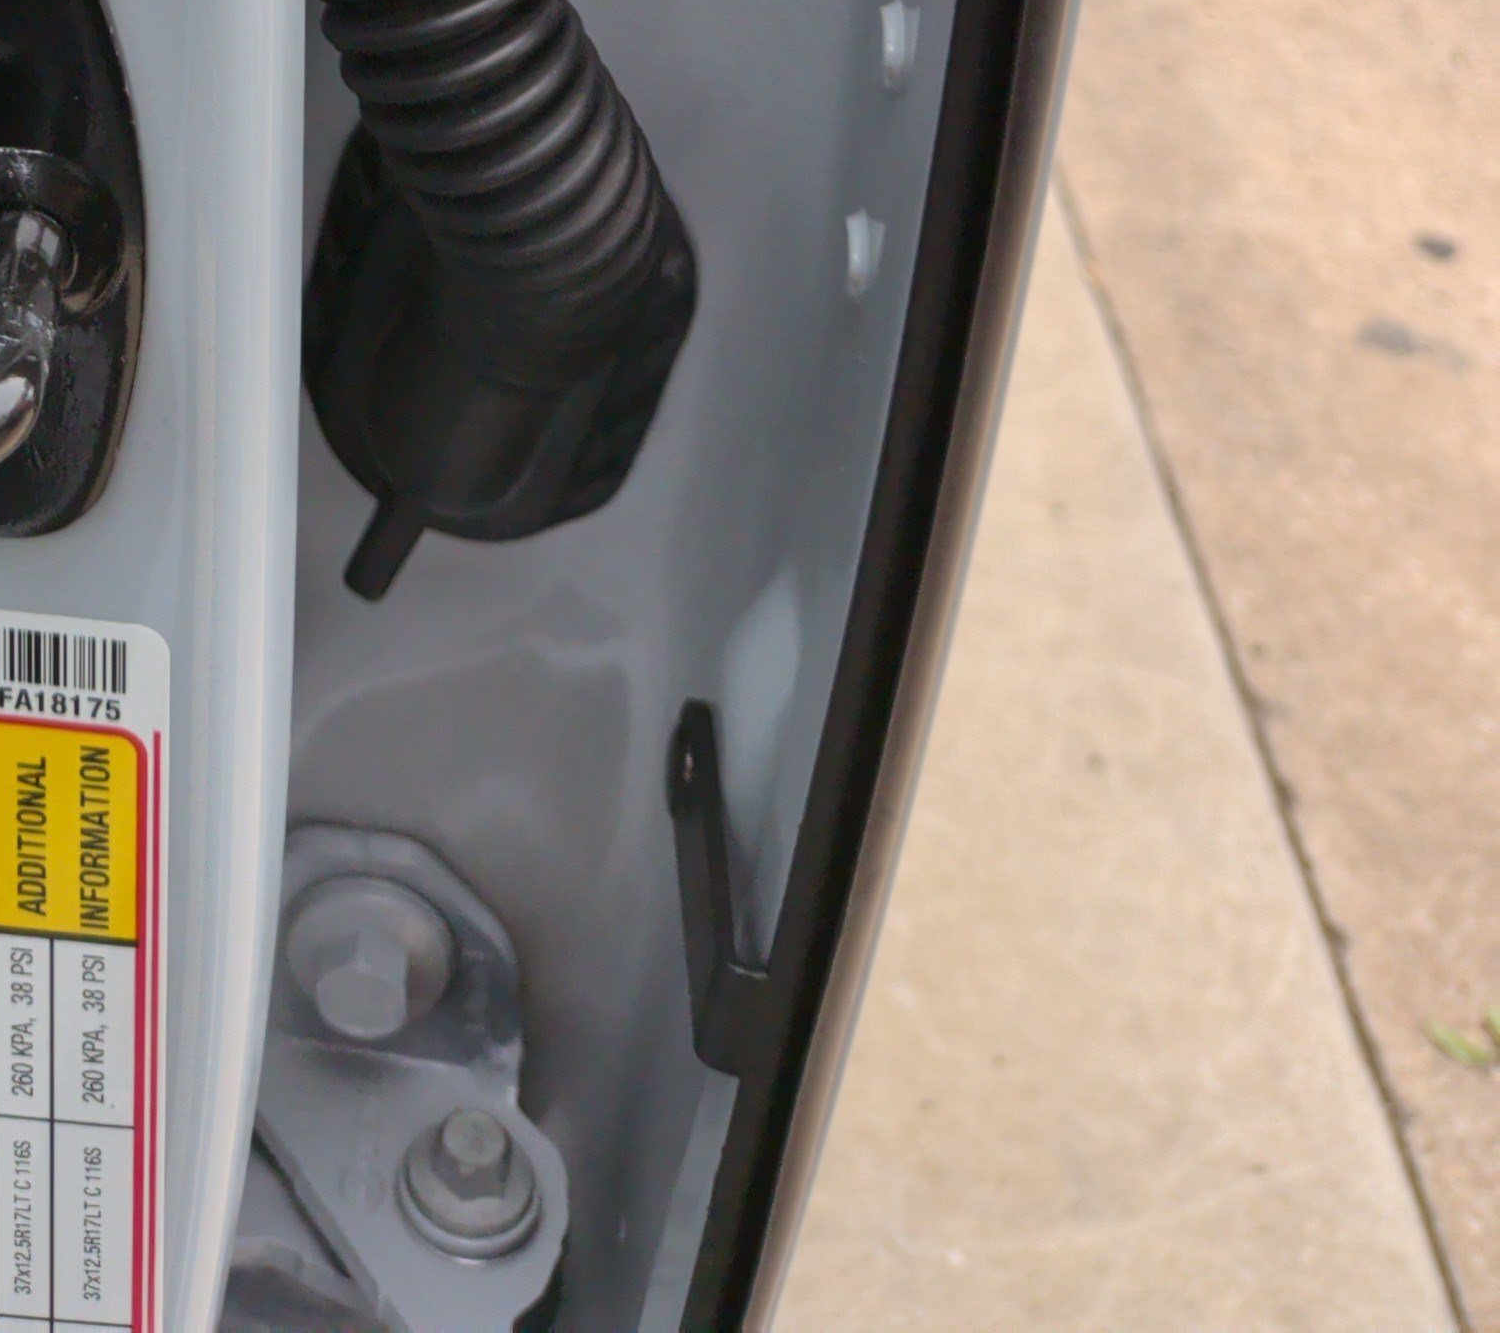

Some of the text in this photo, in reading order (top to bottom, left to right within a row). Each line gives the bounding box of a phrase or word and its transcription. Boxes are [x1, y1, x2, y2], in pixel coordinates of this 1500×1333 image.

[17, 757, 46, 916] ADDITIONAL
[80, 746, 110, 930] INFORMATION
[10, 948, 37, 1096] 260 KPA, 38 PSI
[82, 955, 108, 1103] 260 KPA, 38 PSI
[14, 1140, 31, 1294] 37x12.5R17LT 116S
[83, 1147, 102, 1300] 37x12.5R17LT 116S
